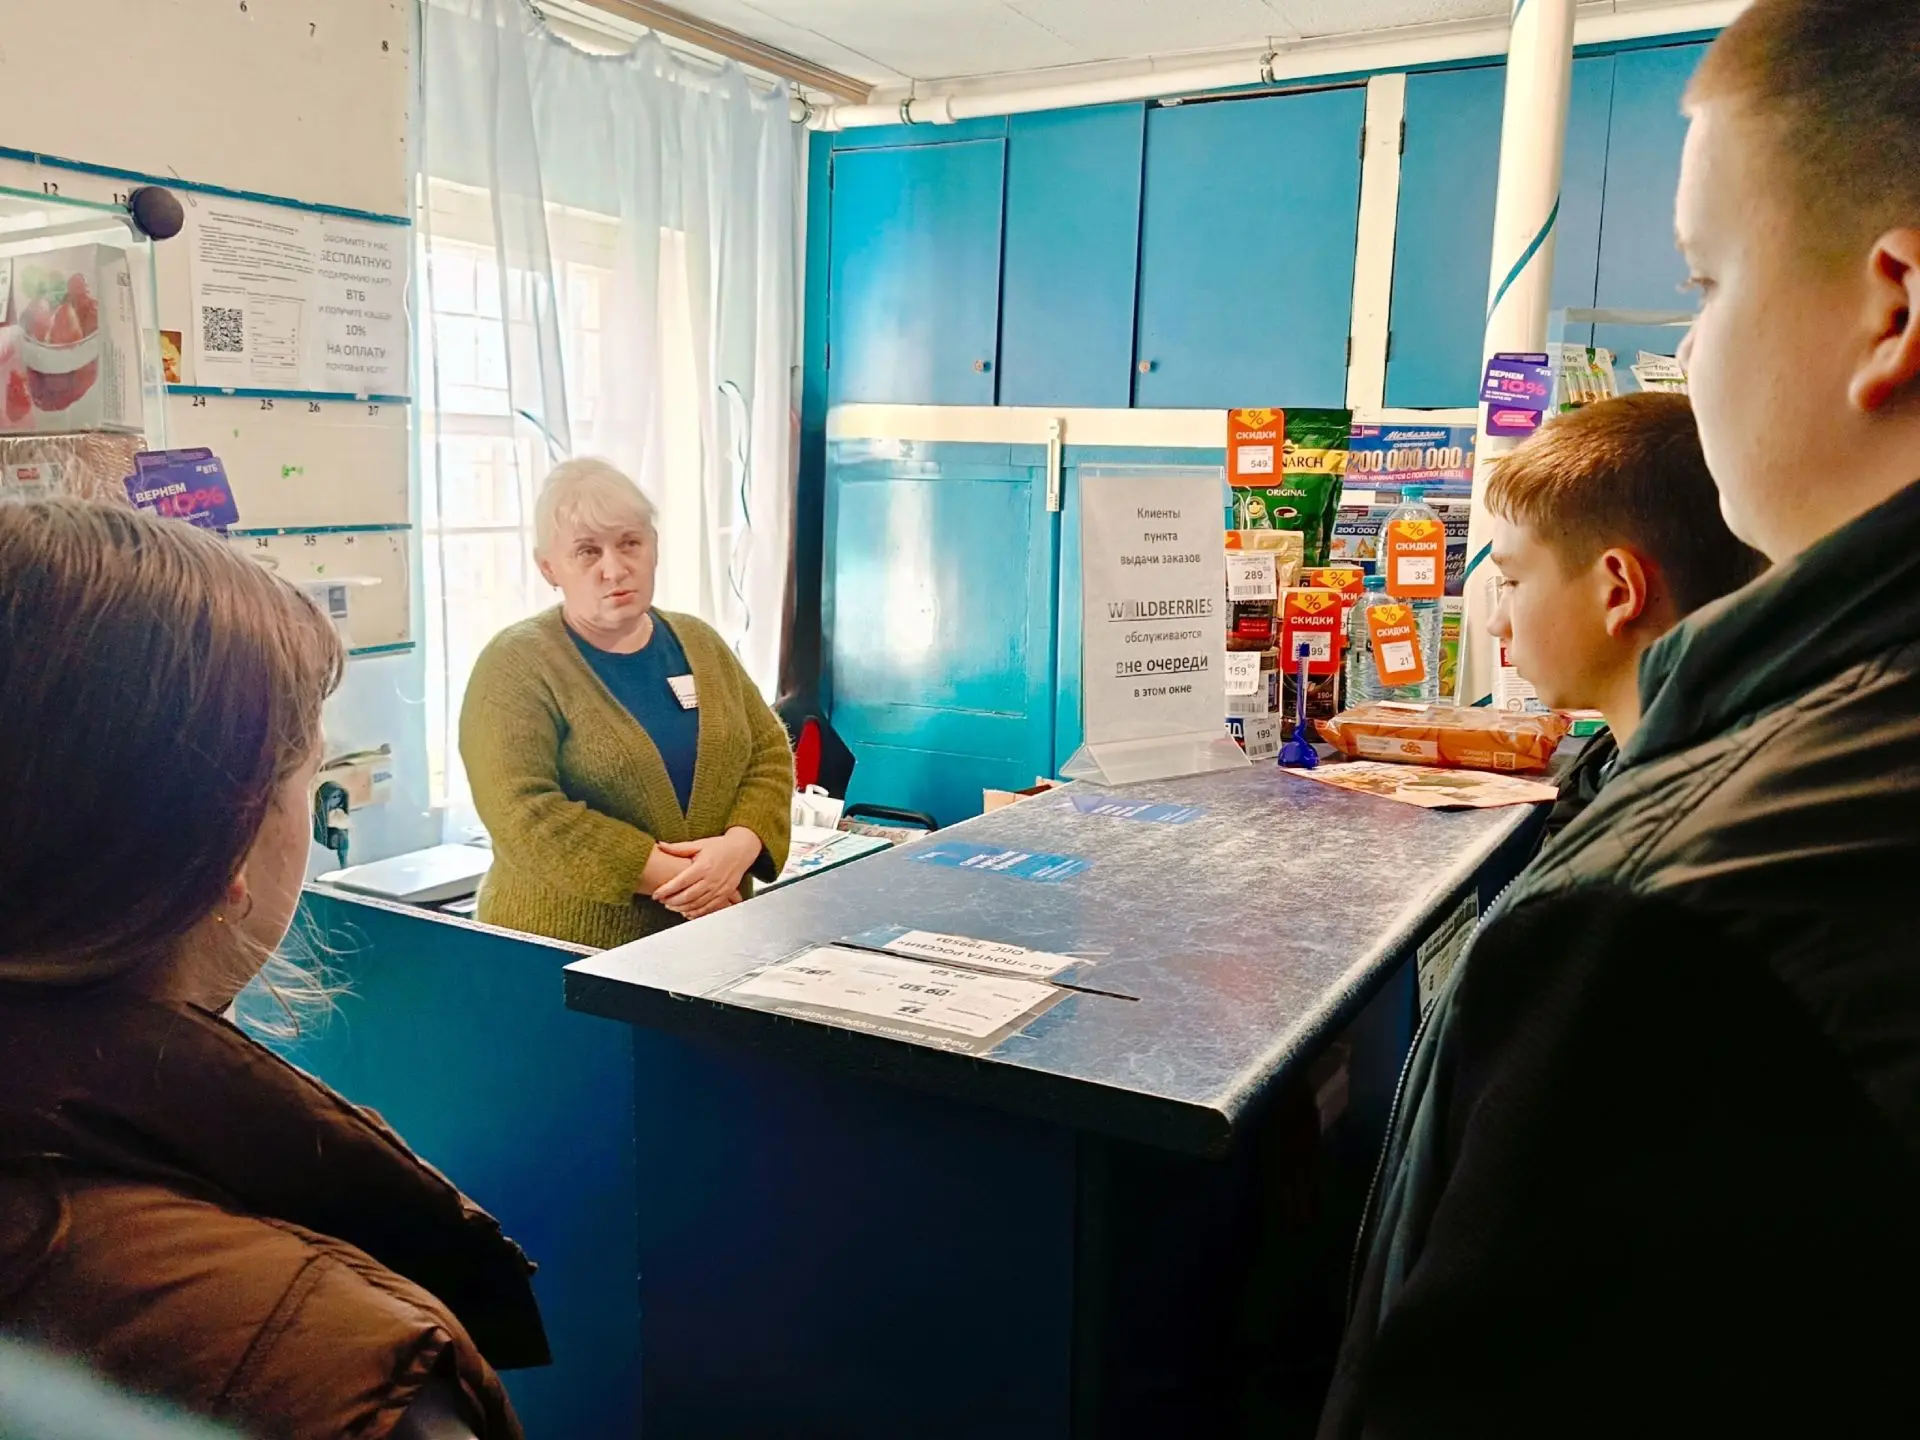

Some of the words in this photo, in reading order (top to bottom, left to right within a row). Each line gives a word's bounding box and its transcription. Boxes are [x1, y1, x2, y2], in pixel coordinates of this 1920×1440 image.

[240, 1, 247, 13] 6
[309, 22, 316, 38] 7
[382, 40, 389, 52] 8
[43, 182, 59, 196] 12
[346, 289, 366, 301] ВТБ
[346, 325, 366, 336] 10%
[327, 344, 341, 354] НА
[344, 345, 386, 358] ОПЛАТУ
[1489, 370, 1525, 380] ВЕРНЕМ
[1501, 380, 1547, 396] 10%
[192, 396, 206, 407] 24
[260, 399, 273, 410] 25
[308, 402, 321, 412] 26
[368, 406, 379, 416] 27
[1236, 431, 1277, 440] СКИДКИ
[1387, 448, 1422, 471] 000
[1426, 447, 1463, 469] 000
[203, 464, 218, 473] ВТБ
[136, 482, 187, 502] ВЕРНЕМ
[1266, 489, 1307, 497] ORIGINAL
[160, 487, 226, 519] 10%
[1137, 507, 1181, 519] Клиенты
[304, 535, 317, 546] 35
[1144, 531, 1178, 543] пункта
[256, 538, 268, 549] 34
[1395, 542, 1437, 550] СКИДКИ
[1120, 555, 1160, 566] выдачи
[1162, 554, 1201, 565] заказов
[1291, 616, 1334, 625] СКИДКИ
[1125, 630, 1202, 644] обслуживаются
[1377, 626, 1410, 636] СКИДКИ
[1116, 661, 1142, 674] вне
[1147, 656, 1208, 673] очереди
[1134, 689, 1139, 697] в
[1142, 688, 1166, 698] этом
[1169, 684, 1191, 695] окне
[991, 947, 1024, 956] ОПС
